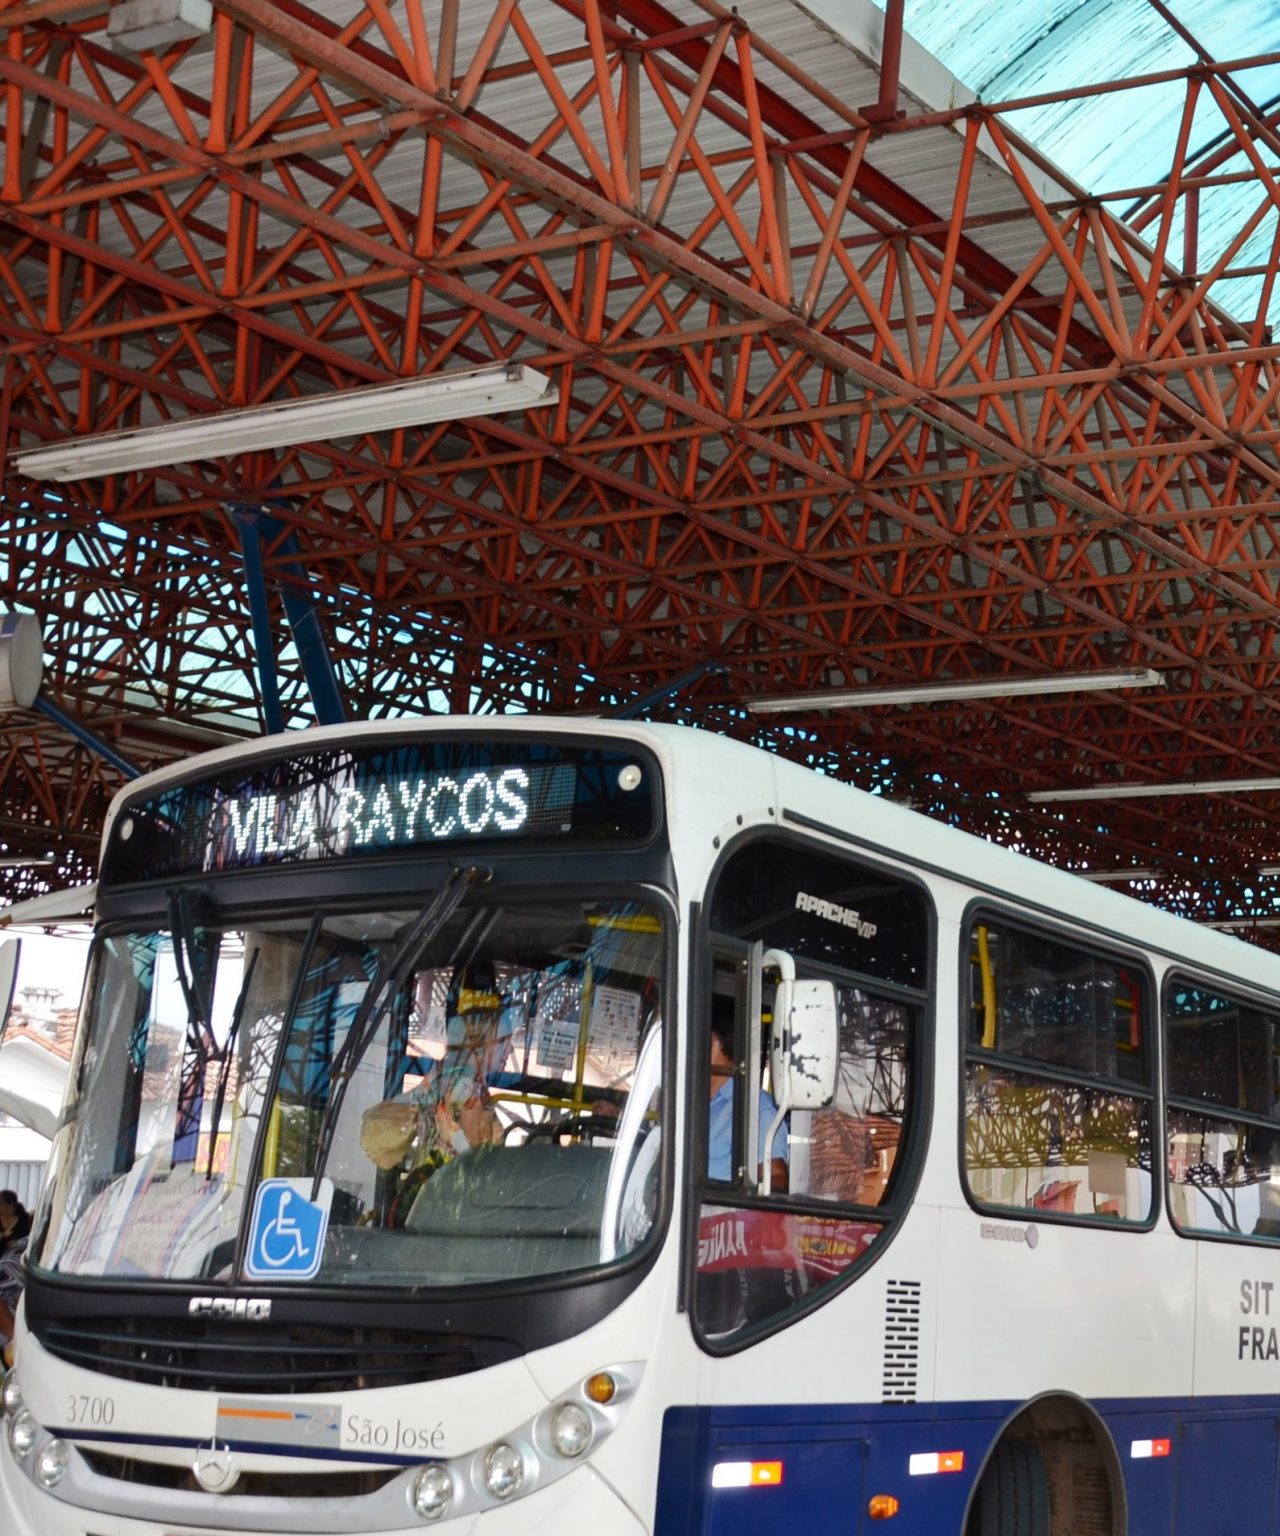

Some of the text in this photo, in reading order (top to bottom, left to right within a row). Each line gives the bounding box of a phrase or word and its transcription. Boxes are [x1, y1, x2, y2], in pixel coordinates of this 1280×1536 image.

[228, 768, 529, 855] VILA RAYCOS
[795, 891, 877, 939] APACHE VIP
[1240, 1279, 1274, 1315] SIT
[66, 1394, 115, 1425] 3700
[346, 1415, 444, 1452] São José
